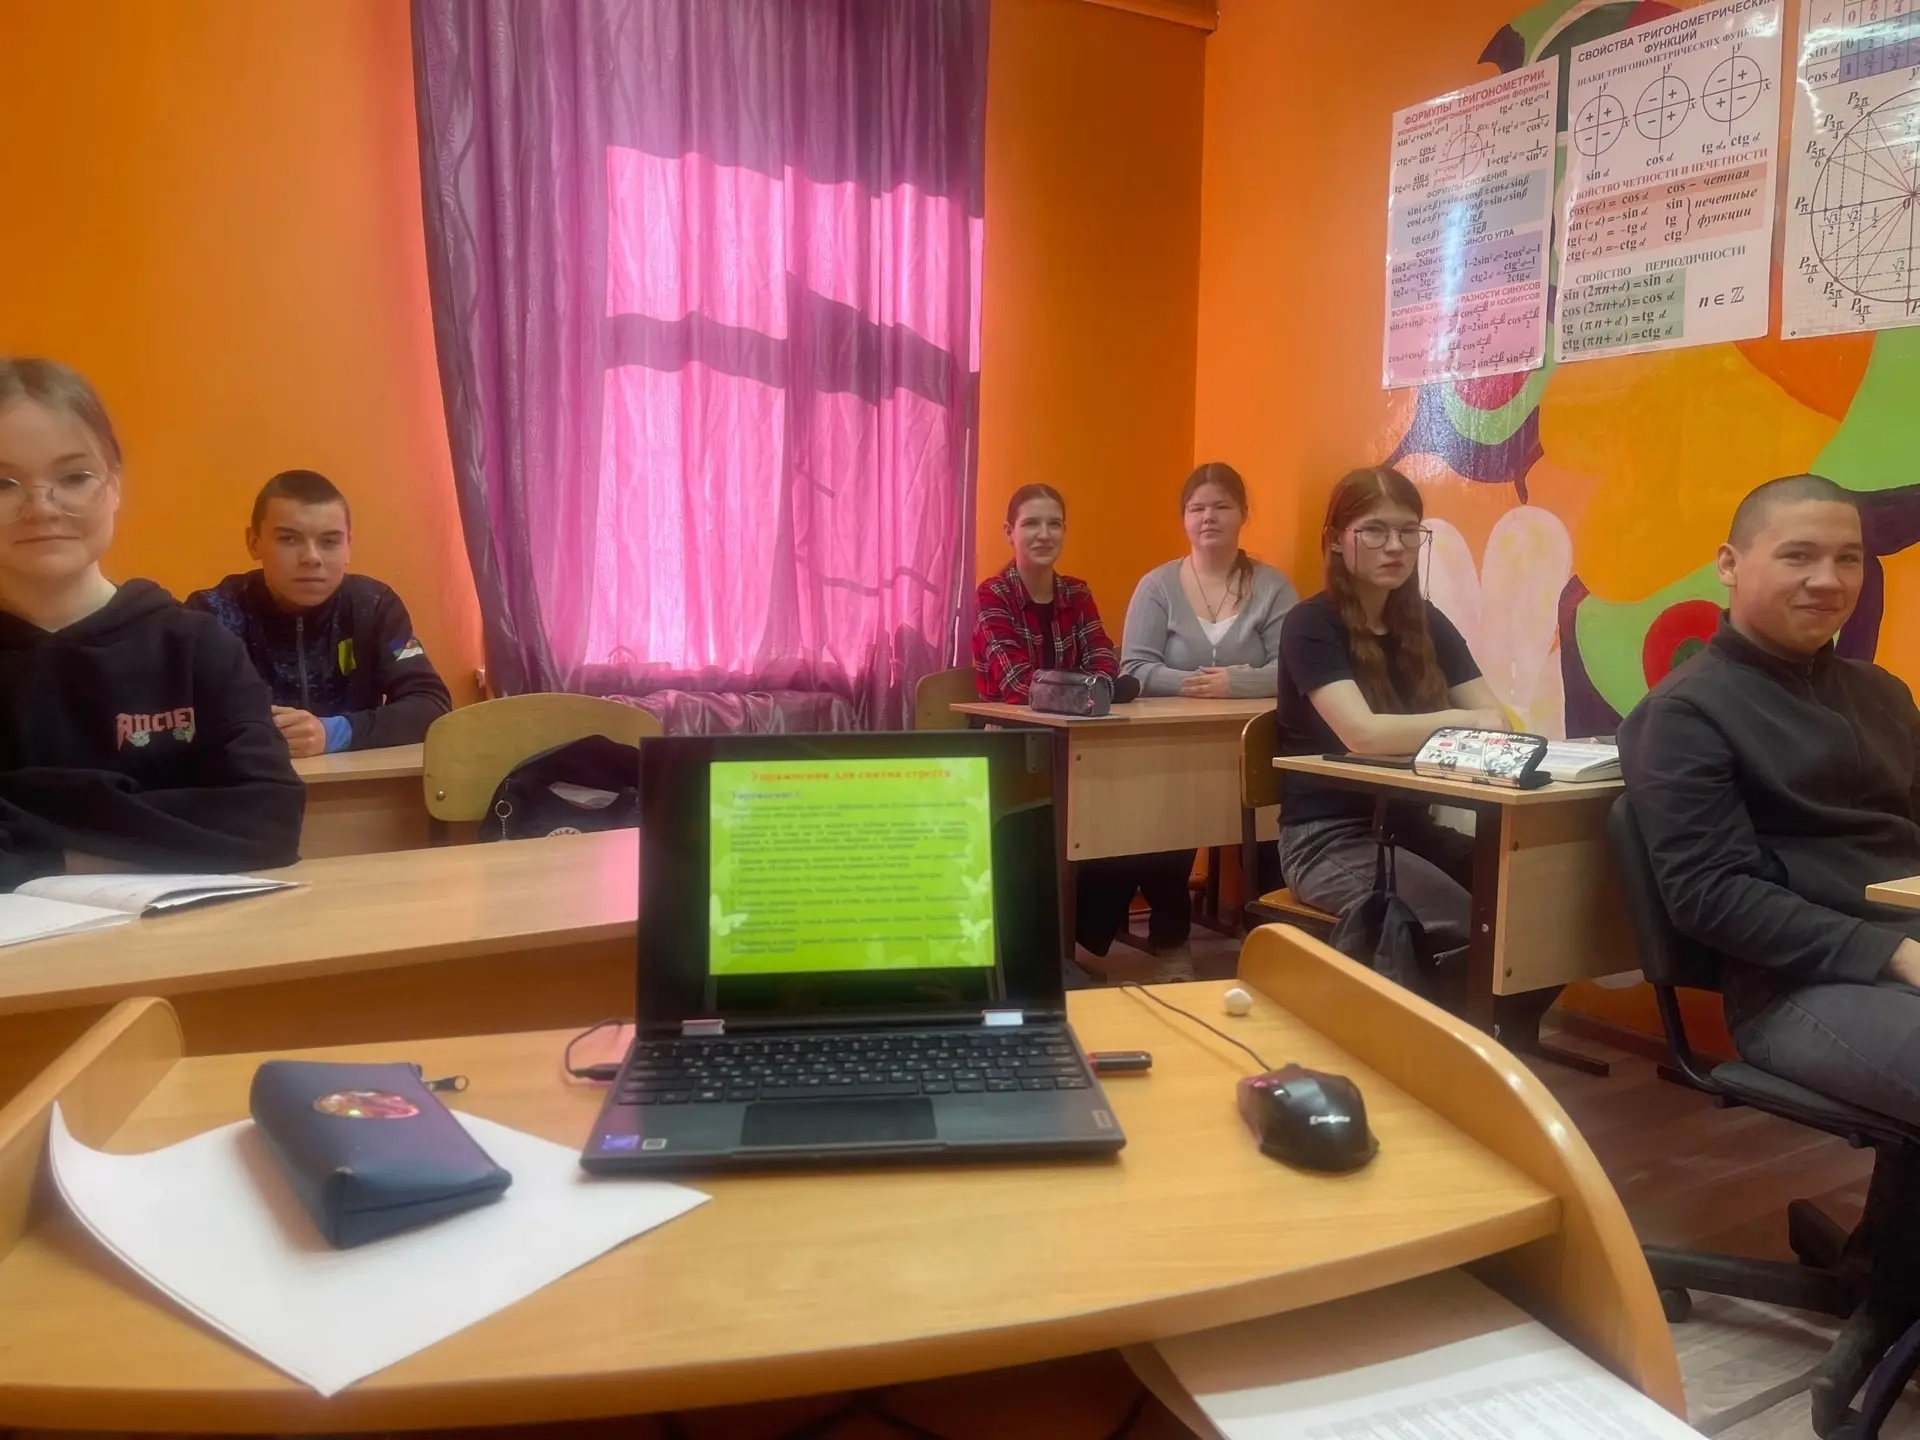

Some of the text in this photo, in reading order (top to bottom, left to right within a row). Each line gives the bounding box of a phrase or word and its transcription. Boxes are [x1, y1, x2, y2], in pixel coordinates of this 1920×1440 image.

[1578, 36, 1635, 63] СВОЙСТВА
[1644, 29, 1697, 54] ФУНКЦИЙ
[1576, 72, 1605, 88] ЗНАКИ
[1606, 37, 1720, 78] ТРИГОНОМЕТРИЧЕСКИХ
[1807, 71, 1828, 85] cos
[1404, 69, 1545, 125] ФОРМУЛЫ ТРИГОНОМЕТРИИ
[1434, 94, 1510, 124] тригонометрические
[1512, 80, 1551, 98] формулы
[1702, 142, 1713, 154] tg
[1731, 134, 1750, 148] ctg
[1622, 168, 1679, 189] ЧЕТНОСТИ
[1691, 148, 1768, 172] НЕЧЕТНОСТИ
[1646, 155, 1664, 167] cos
[1586, 169, 1601, 181] sin
[1667, 183, 1686, 195] cos
[1703, 169, 1750, 187] четная
[1622, 193, 1640, 205] cos
[1666, 188, 1758, 211] sin нечетные
[1665, 207, 1751, 229] tg функции
[1495, 229, 1515, 240] УГЛА
[1664, 230, 1683, 242] ctg
[1576, 246, 1746, 285] СВОЙСТВО ПЕРИОДИЧНОСТИ
[1807, 274, 1814, 284] 6
[1460, 288, 1500, 303] РАЗНОСТИ
[1502, 281, 1541, 296] СИНУСОВ
